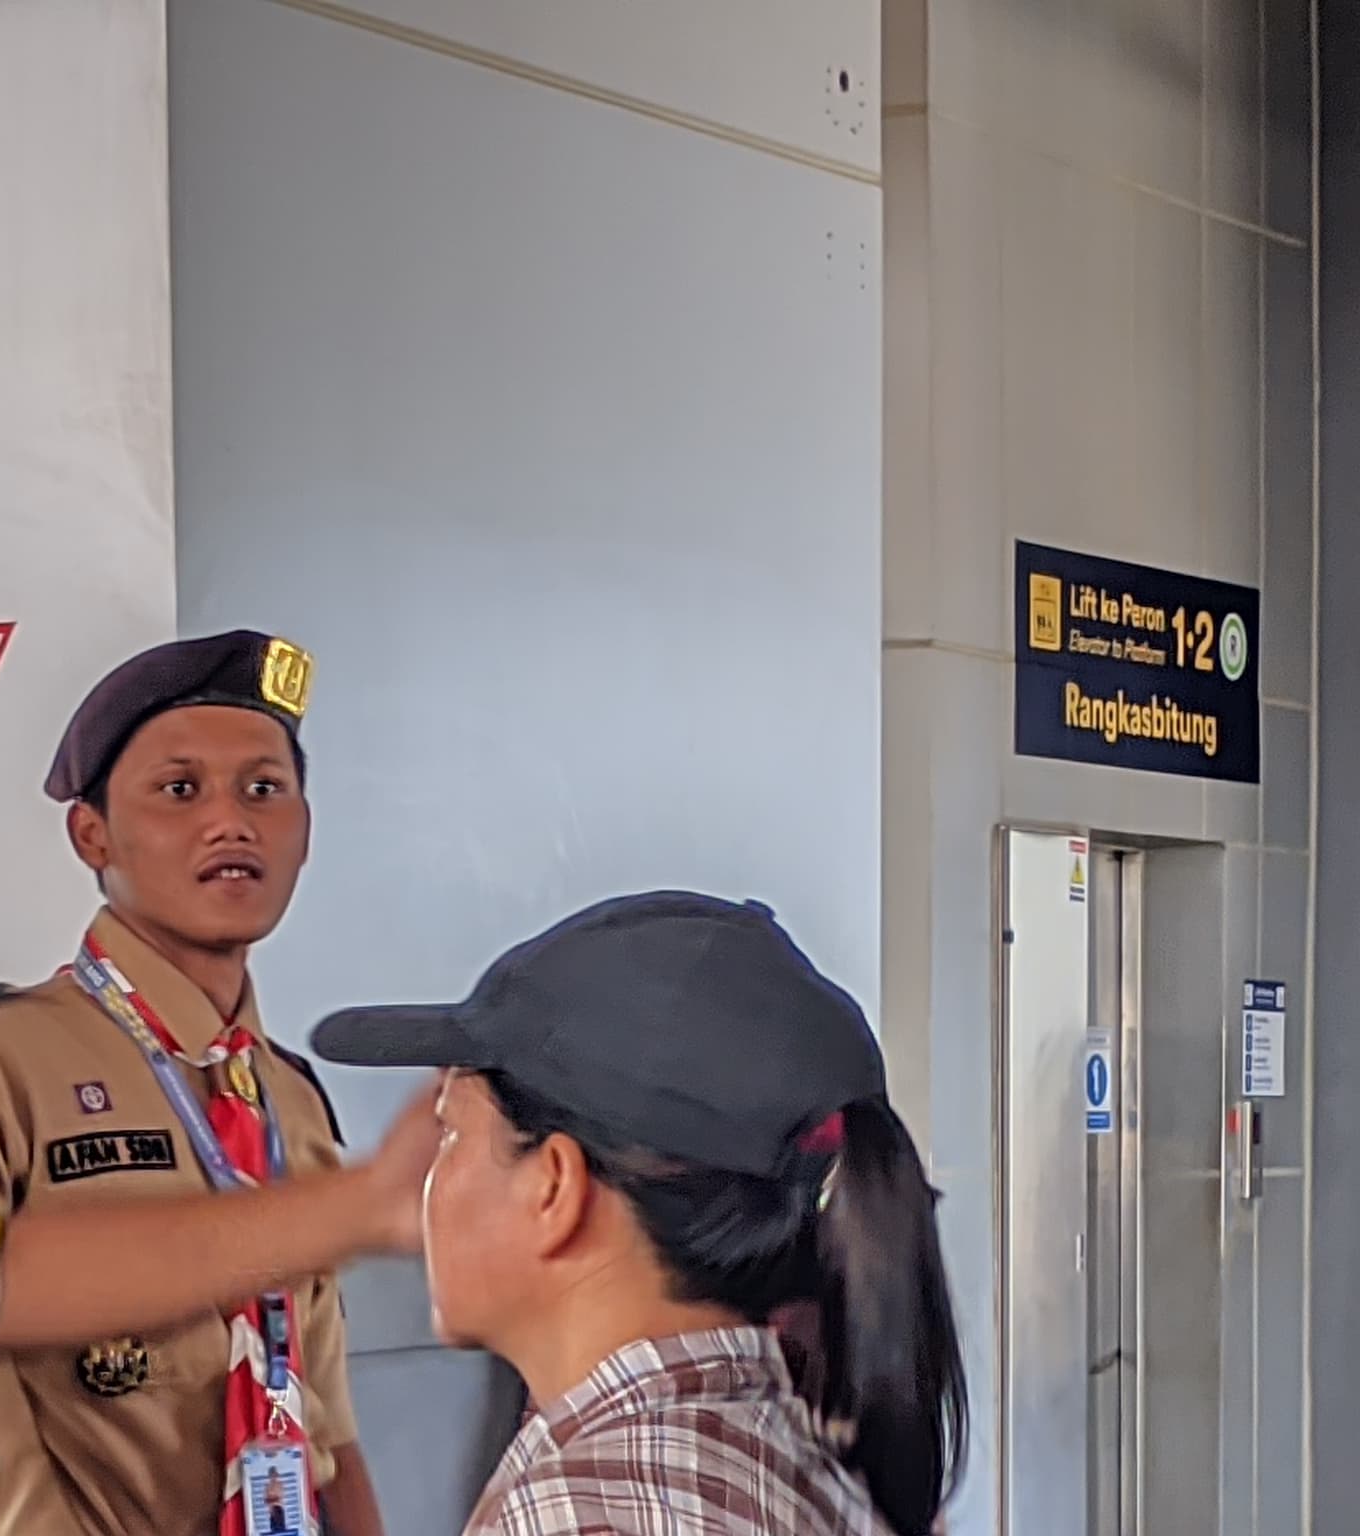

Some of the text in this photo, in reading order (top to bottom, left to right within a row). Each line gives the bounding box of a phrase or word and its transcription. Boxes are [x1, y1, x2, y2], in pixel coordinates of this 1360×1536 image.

[1070, 583, 1098, 621] Lift
[1100, 588, 1120, 625] ke
[1122, 593, 1166, 632] Peron
[1065, 681, 1217, 757] Rangkasbitung
